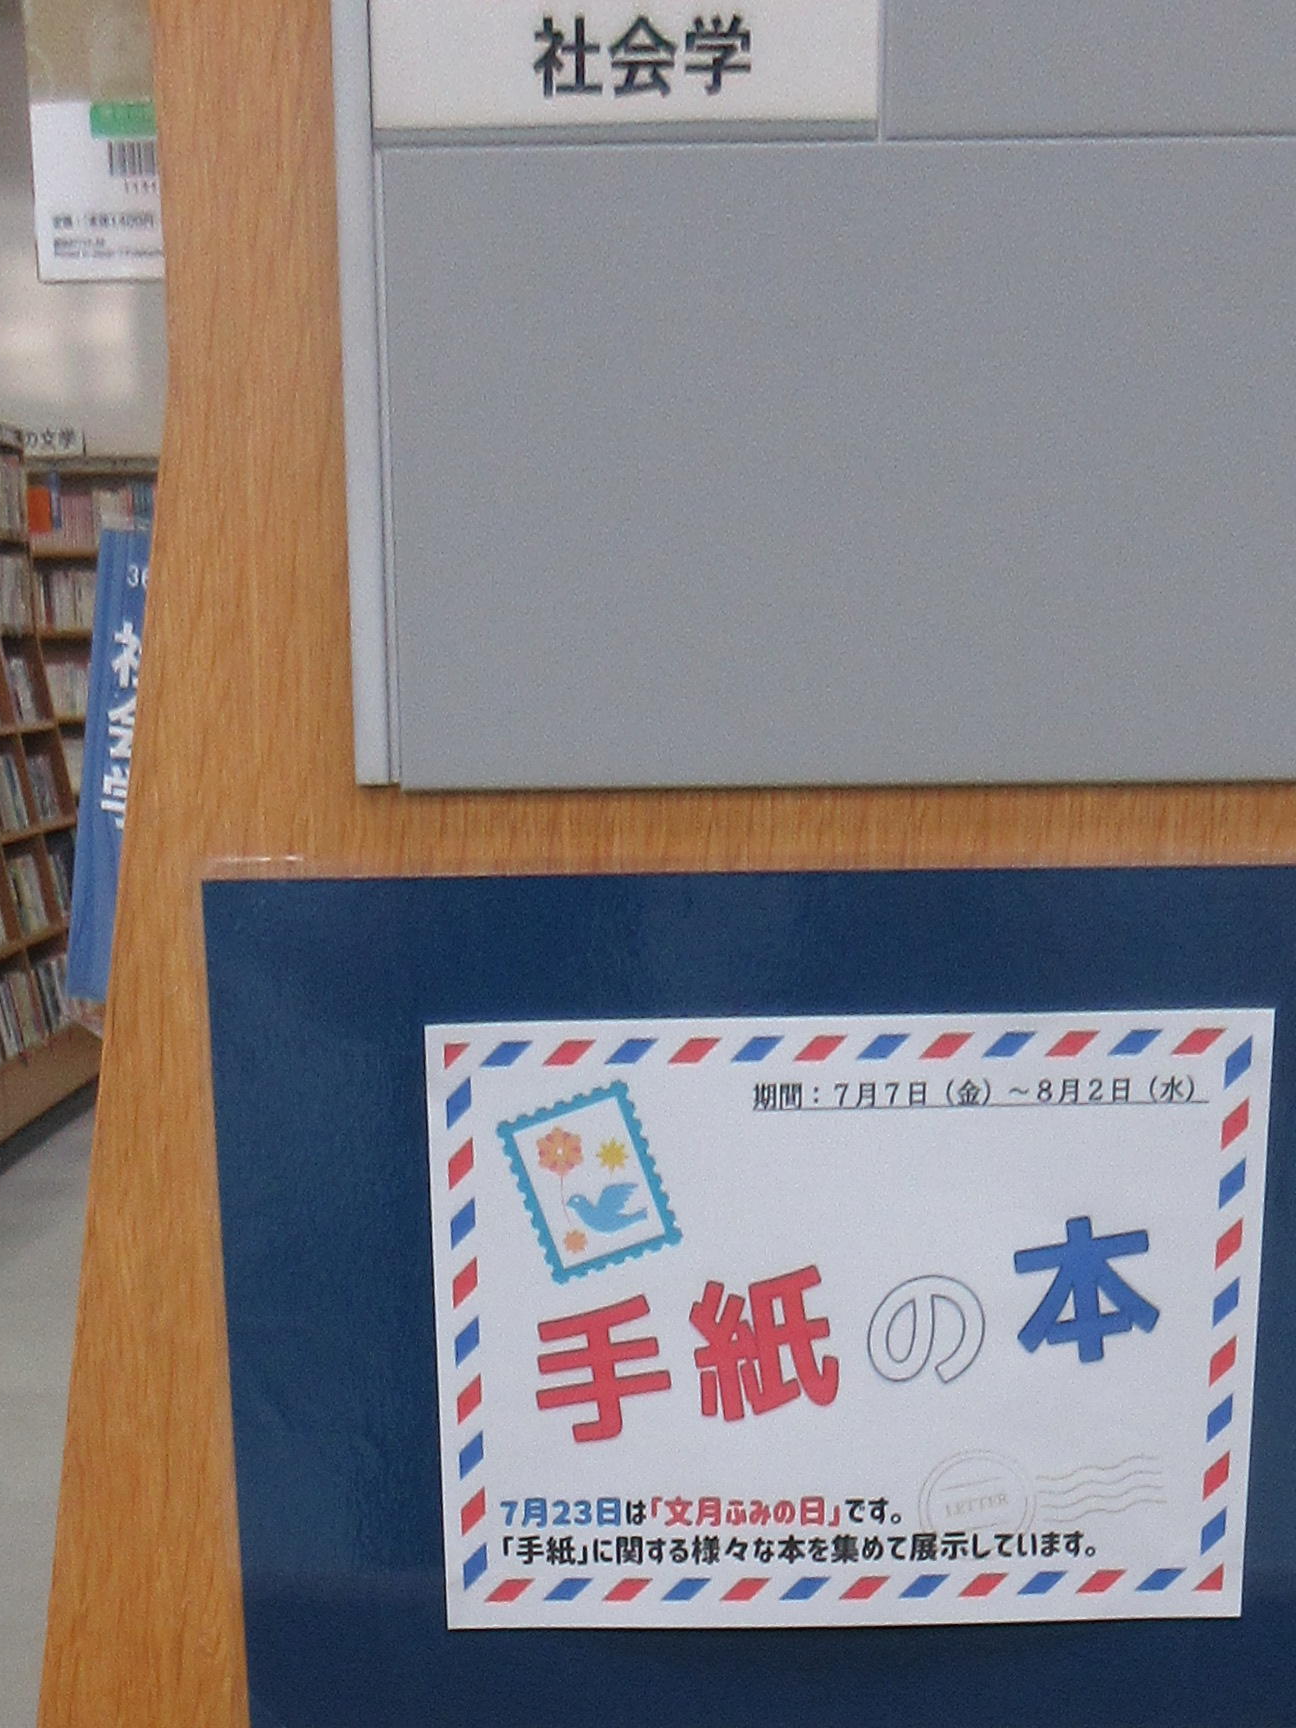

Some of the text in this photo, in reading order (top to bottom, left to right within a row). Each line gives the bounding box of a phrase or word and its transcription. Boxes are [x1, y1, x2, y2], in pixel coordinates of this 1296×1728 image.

[533, 15, 752, 98] 社会学
[534, 1215, 1160, 1444] 手紙の本
[502, 1532, 1098, 1568] 「手紙」に関する様々な本を集めて展示しています。
